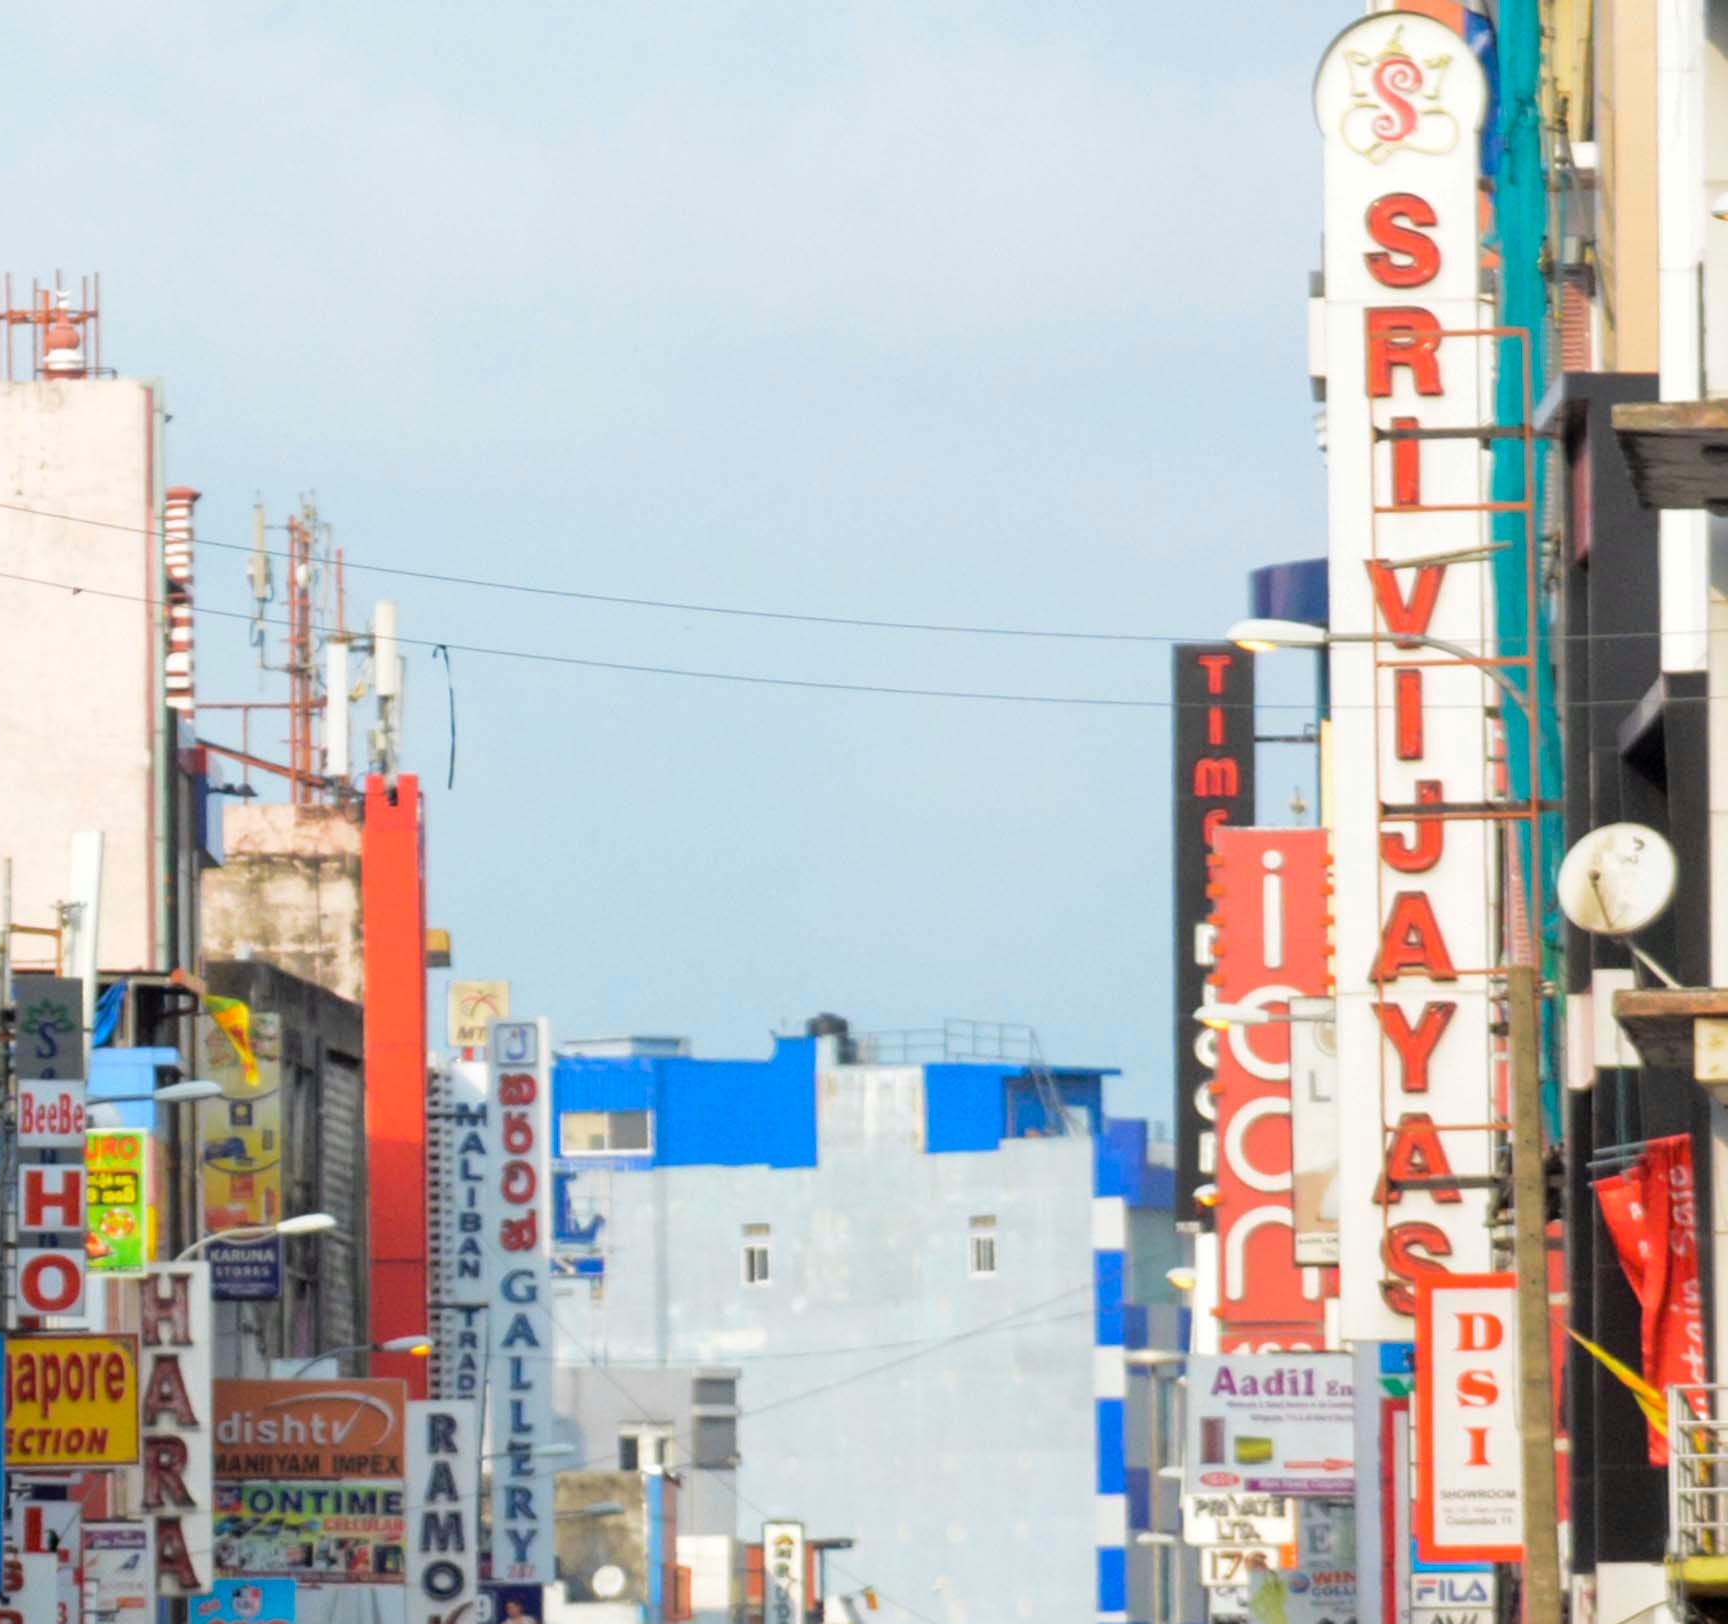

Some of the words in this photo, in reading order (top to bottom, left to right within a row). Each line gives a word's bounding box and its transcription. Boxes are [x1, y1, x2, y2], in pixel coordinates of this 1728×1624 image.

[1211, 1366, 1316, 1397] Aadil
[1454, 1312, 1504, 1468] DSI
[249, 1489, 404, 1514] ONTIME
[1416, 1578, 1489, 1602] FILA
